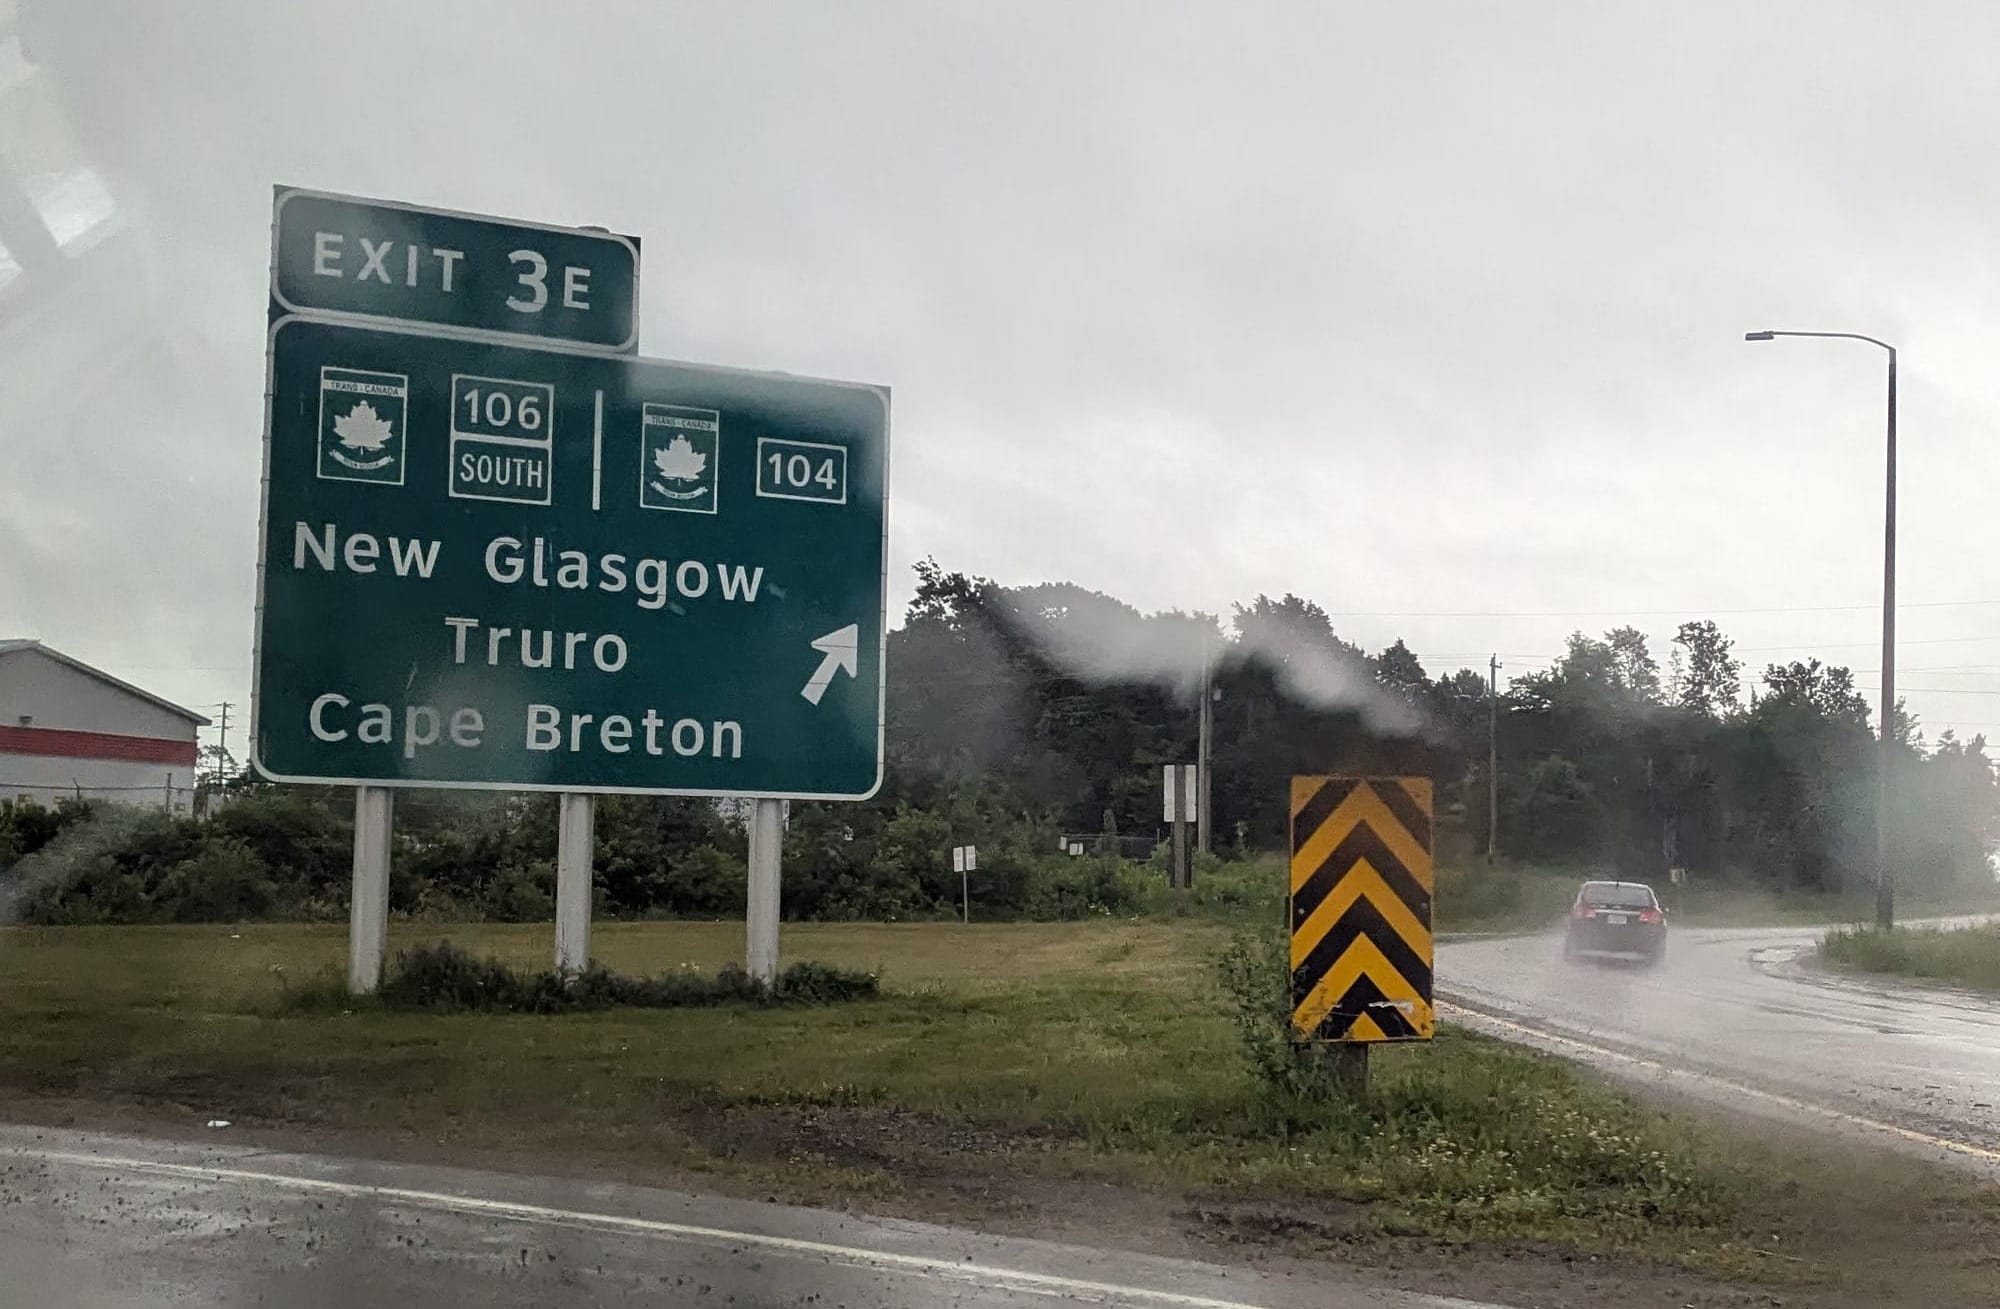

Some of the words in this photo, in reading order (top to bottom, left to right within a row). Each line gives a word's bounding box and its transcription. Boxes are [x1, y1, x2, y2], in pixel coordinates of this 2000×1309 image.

[313, 231, 465, 293] EXIT
[463, 388, 541, 430] 106
[460, 453, 543, 489] SOUTH
[768, 452, 837, 490] 104
[294, 521, 442, 579] New
[484, 536, 764, 610] Glasgow
[445, 616, 628, 673] Truro
[309, 692, 485, 759] Cape
[525, 704, 743, 759] Breton
